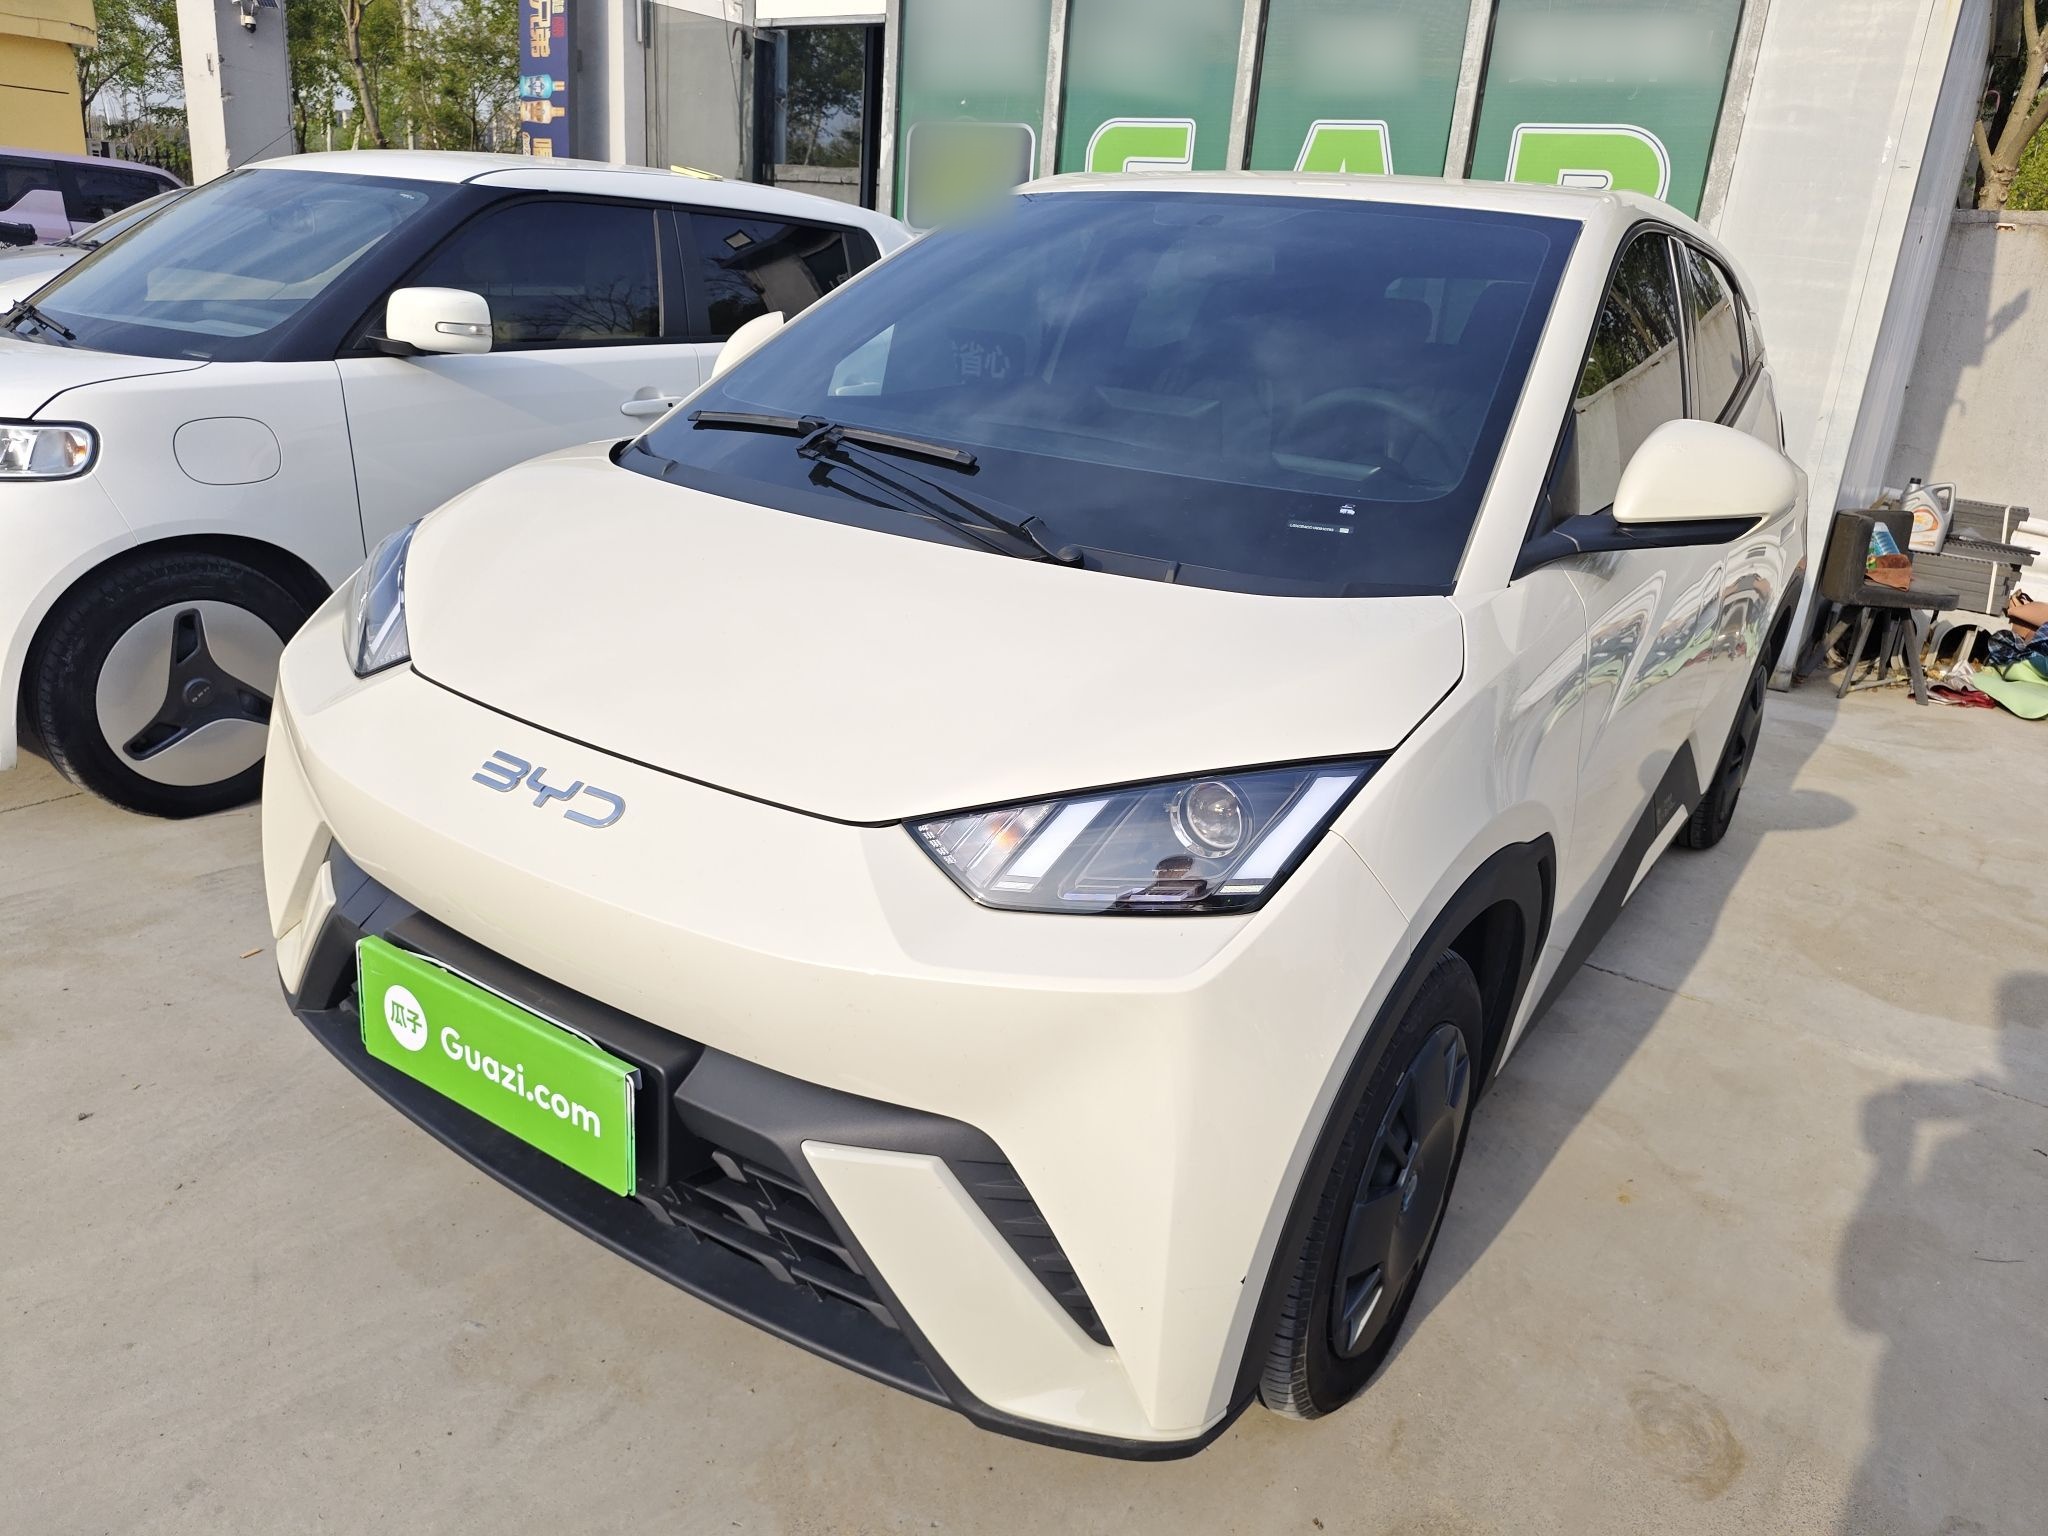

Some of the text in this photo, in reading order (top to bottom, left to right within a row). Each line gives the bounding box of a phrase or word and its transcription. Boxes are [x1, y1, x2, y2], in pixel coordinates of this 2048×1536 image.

[471, 749, 626, 828] BYD
[390, 998, 423, 1035] 瓜子
[440, 1026, 601, 1138] Guazi.com
